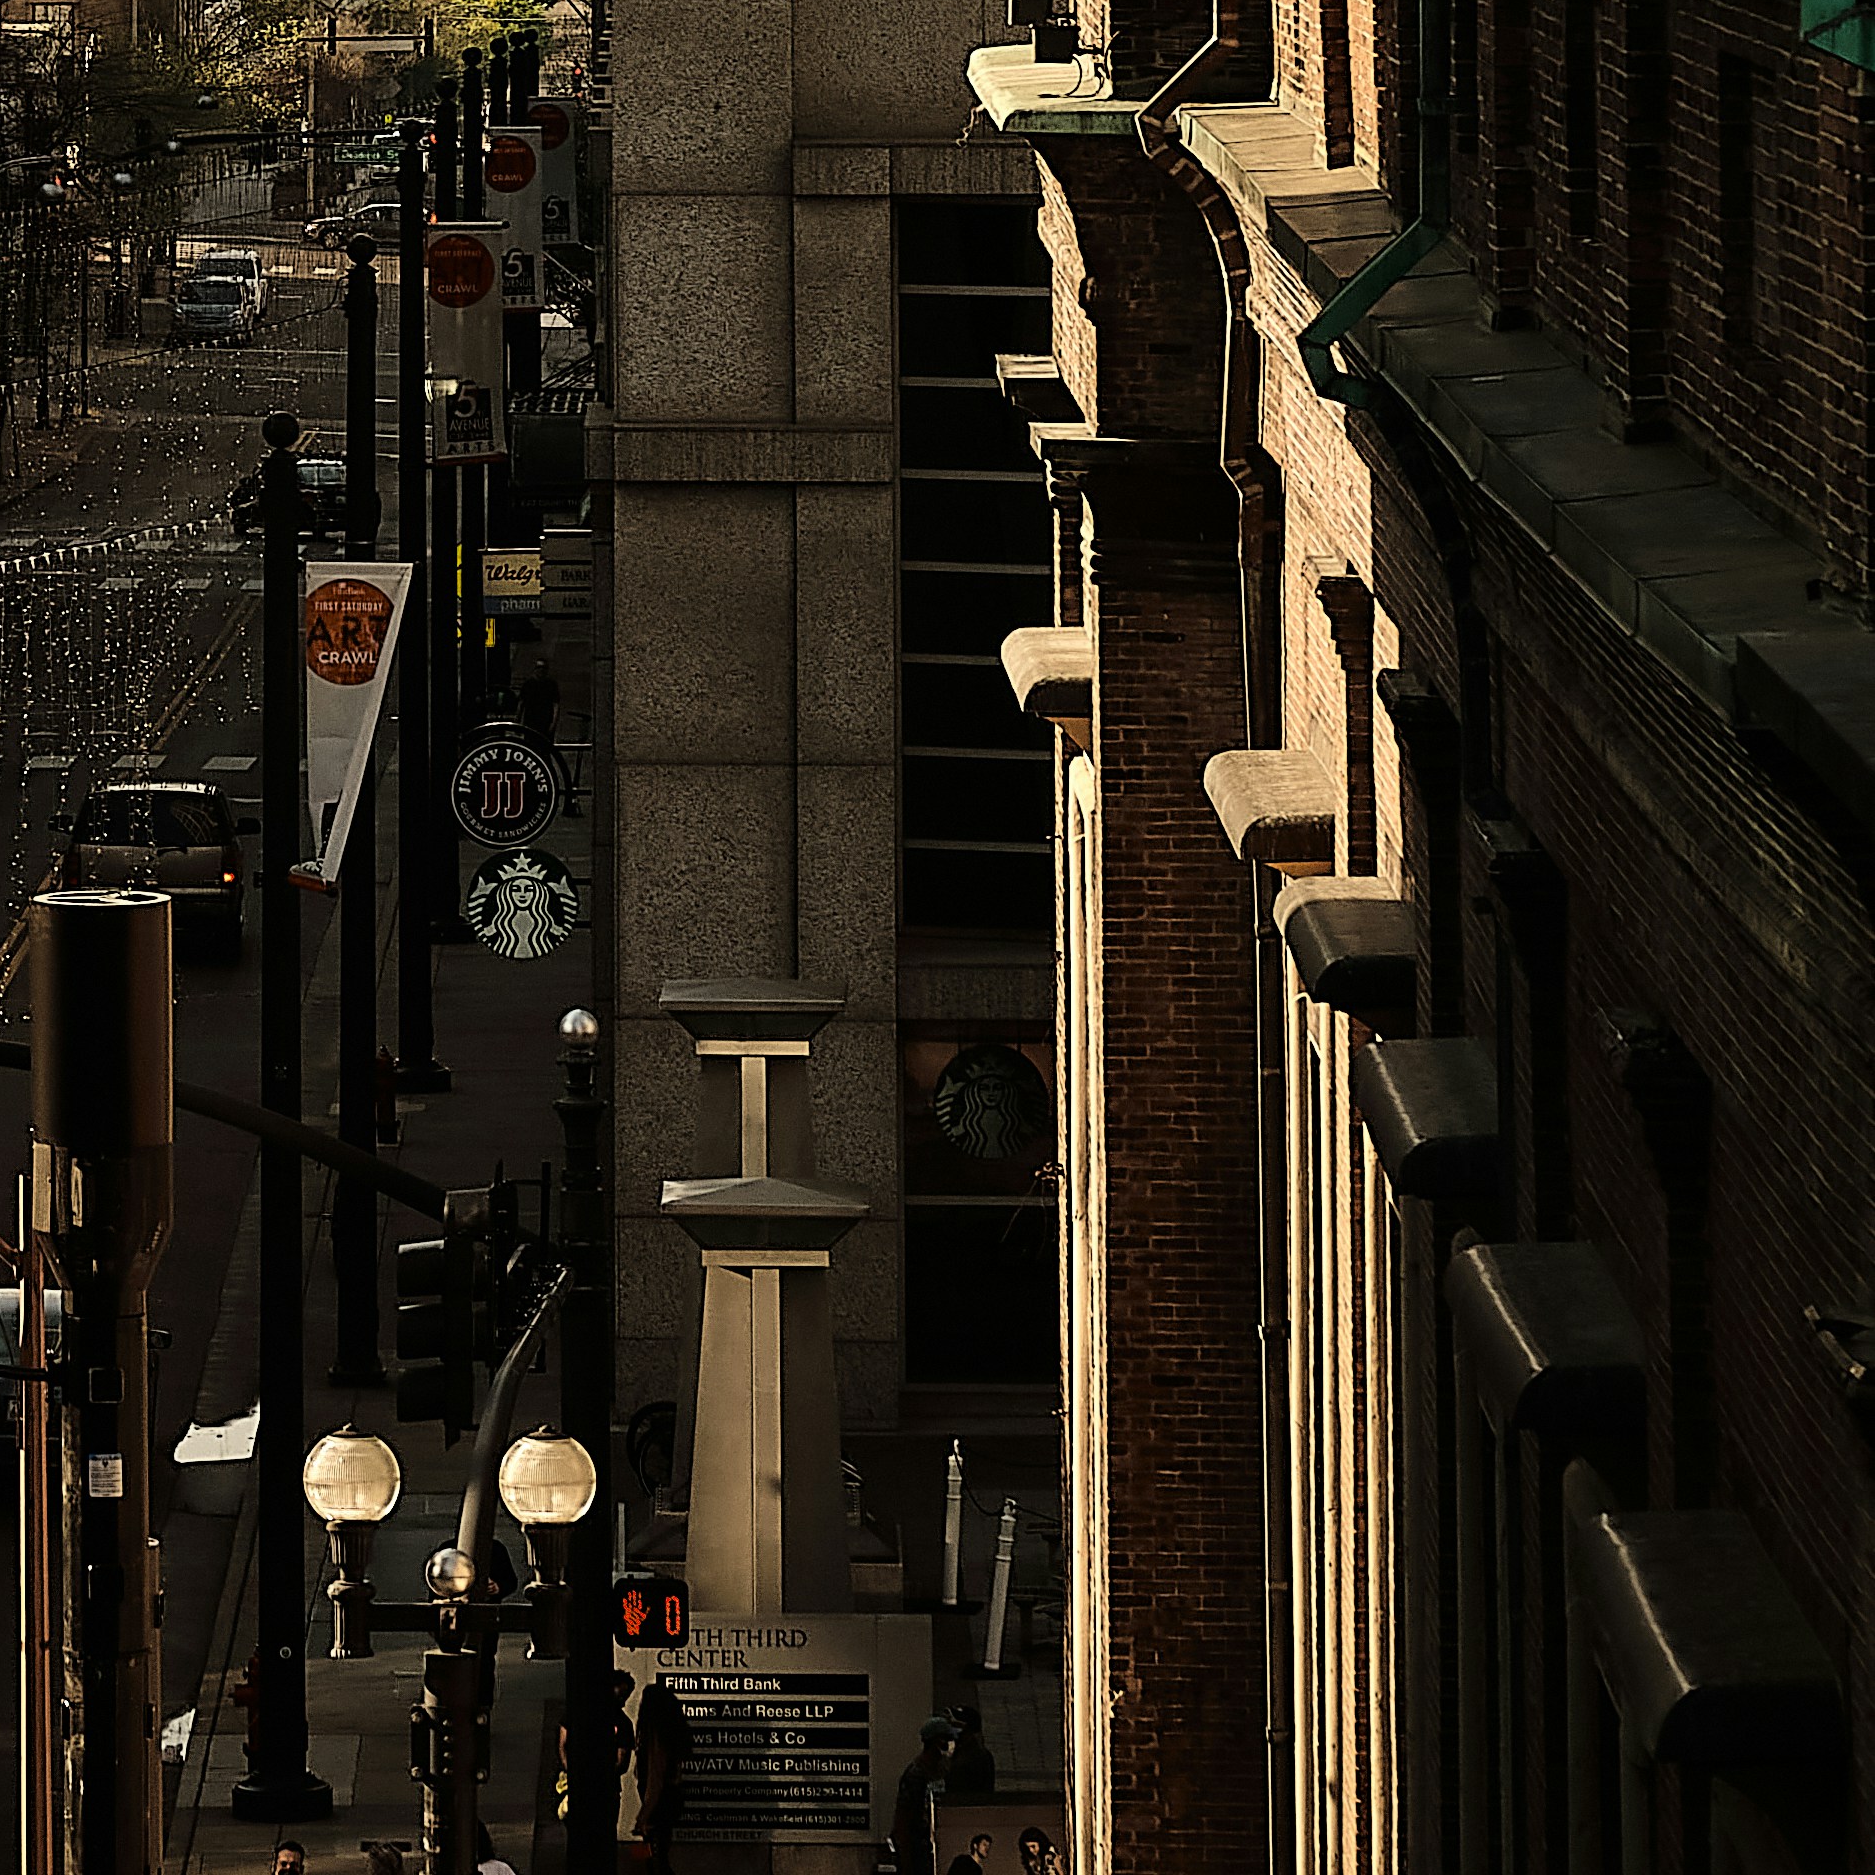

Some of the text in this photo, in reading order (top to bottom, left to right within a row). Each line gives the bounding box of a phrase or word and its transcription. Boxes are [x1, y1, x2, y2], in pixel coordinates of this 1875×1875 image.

[491, 173, 524, 182] CRAWL
[437, 284, 479, 294] CRAWL
[449, 418, 490, 431] AVENUE
[446, 441, 495, 455] ARTS
[314, 601, 384, 612] FIRST SATURDAY
[318, 650, 377, 665] CRAWL
[458, 748, 549, 794] JIMMY JOHN'S
[480, 771, 526, 819] JJ
[731, 1628, 808, 1648] THIRD
[657, 1649, 749, 1668] CENTER
[665, 1676, 782, 1691] Fifth Third Bank
[682, 1703, 834, 1718] ams And Reese LLP
[718, 1731, 765, 1744] Hotels
[769, 1731, 779, 1745] &
[784, 1731, 806, 1745] Co
[738, 1758, 781, 1771] Music
[784, 1758, 860, 1775] Publishing
[702, 1786, 743, 1797] Property
[744, 1786, 788, 1798] Company
[675, 1831, 763, 1841] CHURCH STREET
